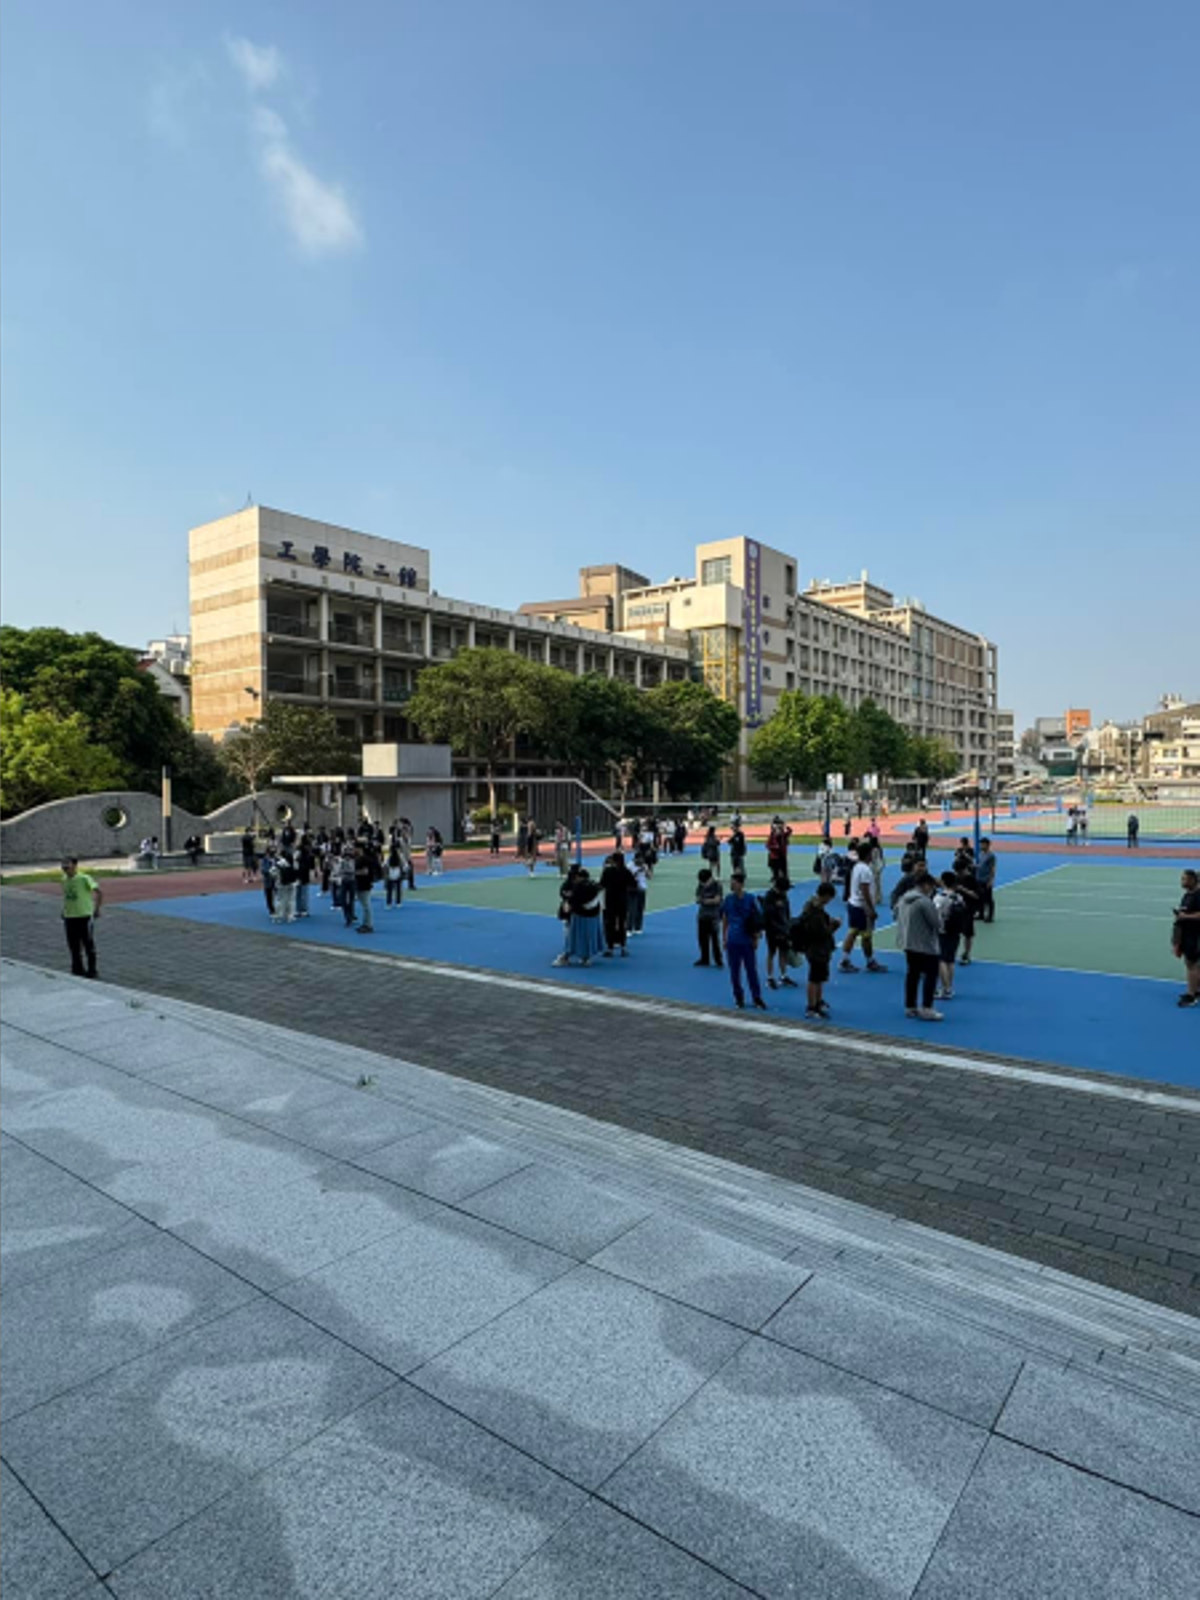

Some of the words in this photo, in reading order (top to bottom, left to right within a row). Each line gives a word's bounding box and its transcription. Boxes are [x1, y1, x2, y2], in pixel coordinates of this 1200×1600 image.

[277, 540, 418, 588] 工學院二館
